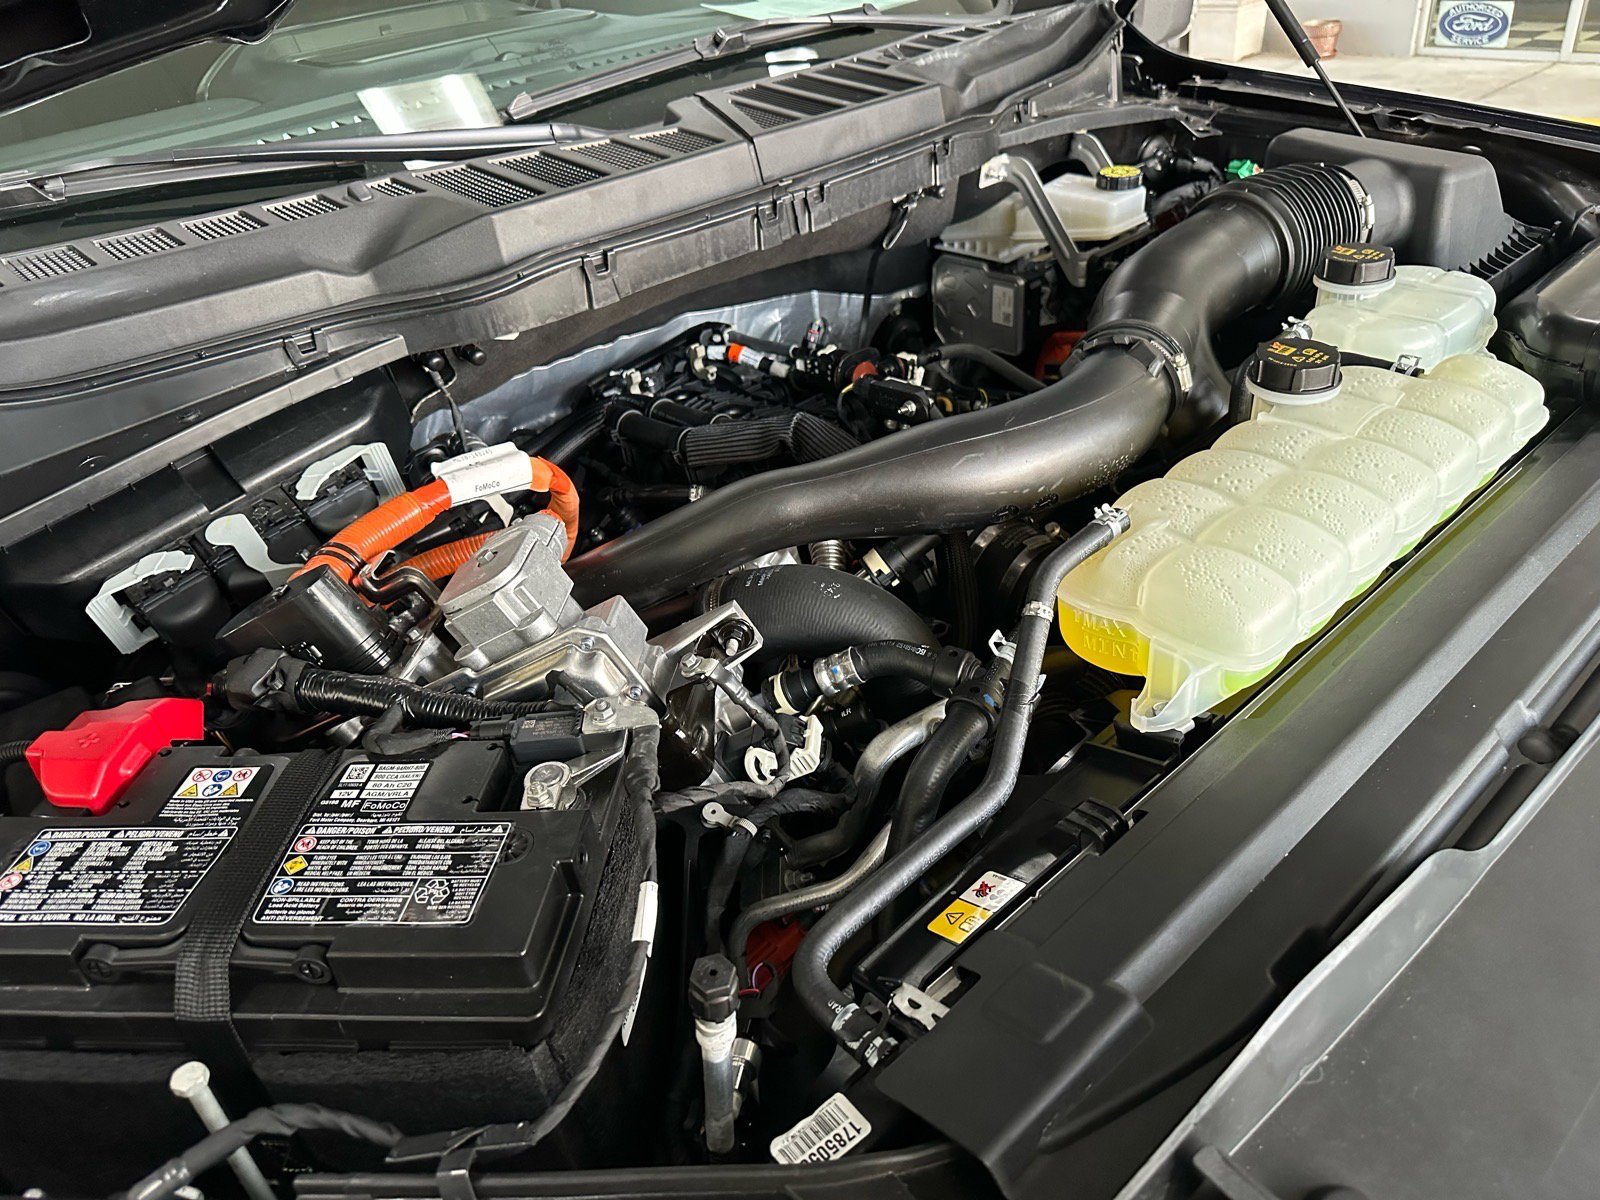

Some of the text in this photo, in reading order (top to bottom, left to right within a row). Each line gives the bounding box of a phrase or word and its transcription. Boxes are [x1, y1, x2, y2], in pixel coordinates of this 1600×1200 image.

[1449, 3, 1504, 17] AUTHORIZED
[1452, 14, 1494, 31] Ford
[1450, 33, 1489, 45] SERVICE
[474, 480, 500, 492] FoMoCo
[1084, 635, 1126, 658] MIN
